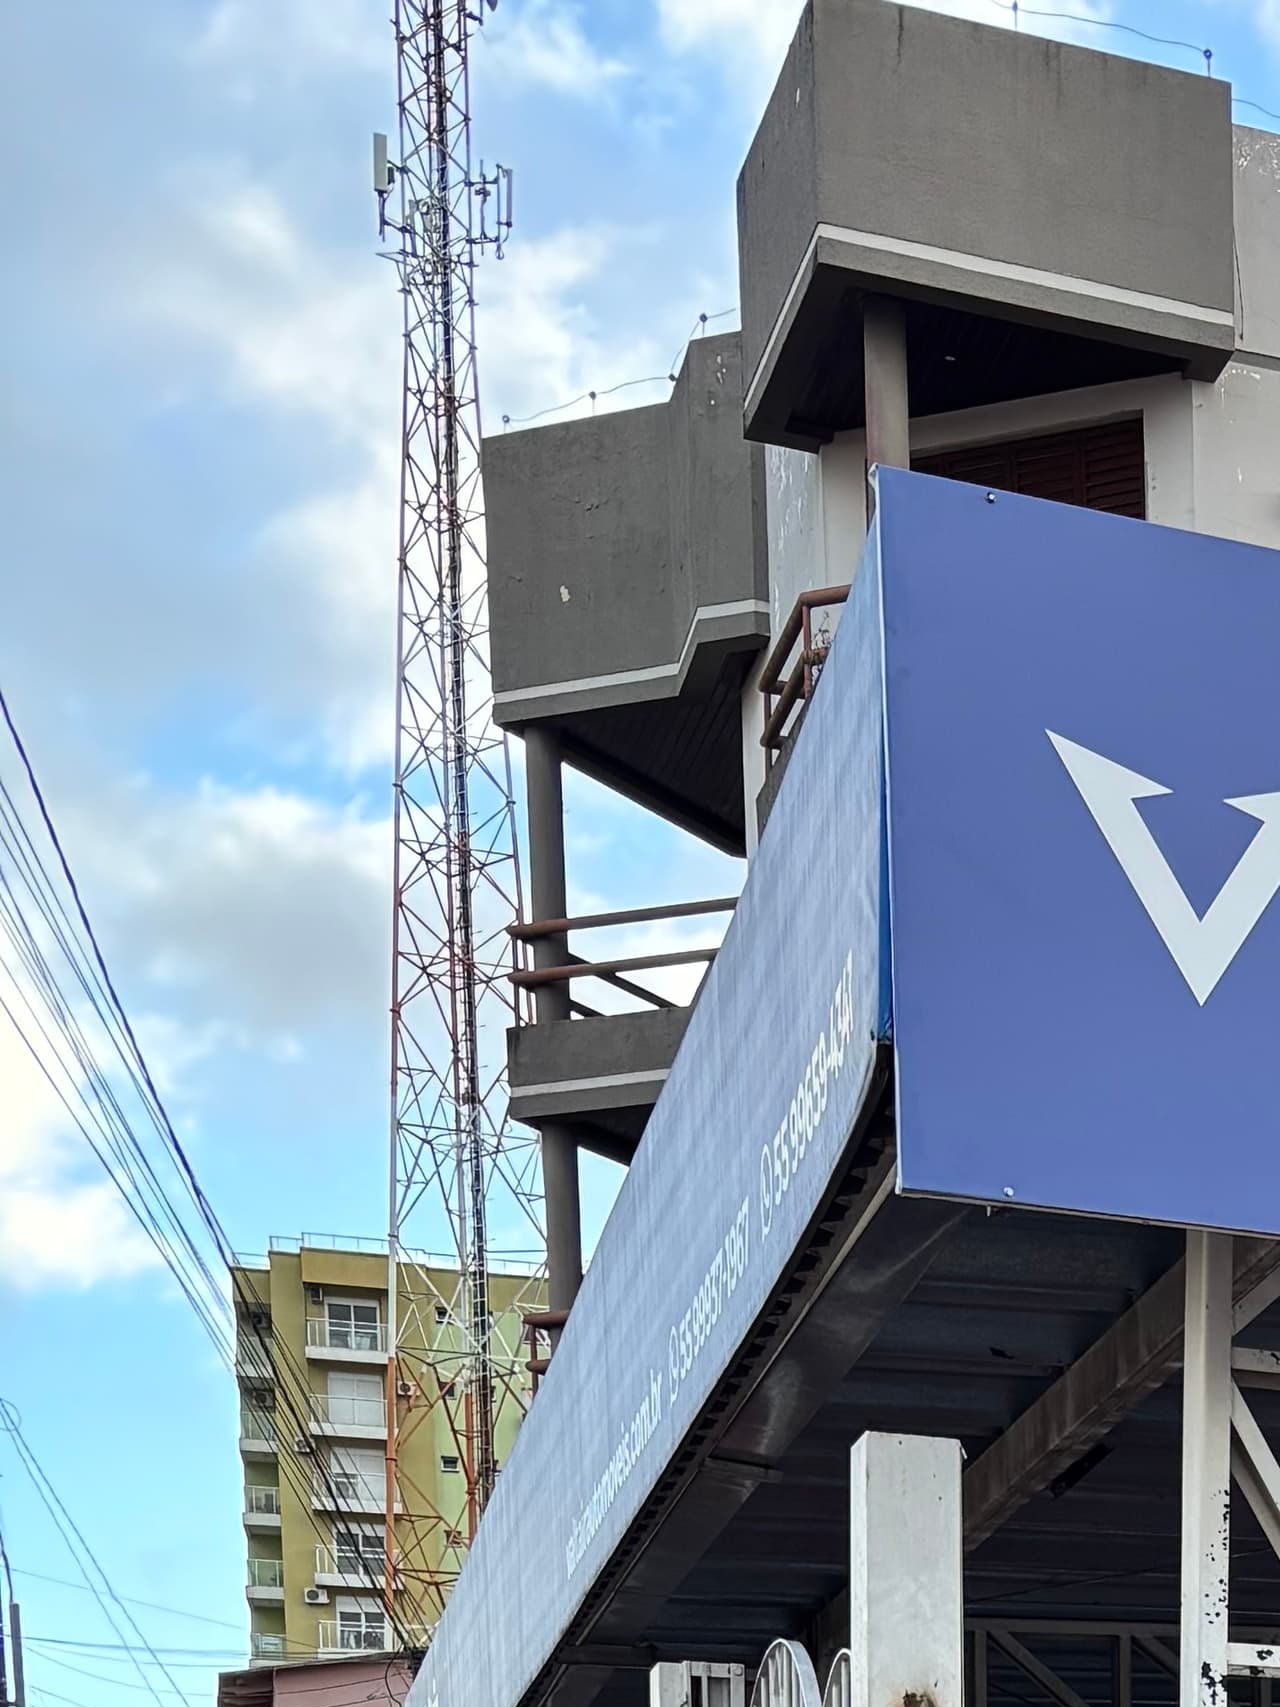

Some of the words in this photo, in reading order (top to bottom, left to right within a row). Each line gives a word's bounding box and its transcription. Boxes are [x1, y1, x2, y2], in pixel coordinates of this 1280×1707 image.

[773, 1116, 790, 1206] 55
[791, 949, 855, 1174] 99659-4341
[680, 1308, 692, 1380] 55
[692, 1196, 749, 1358] 99937-1967
